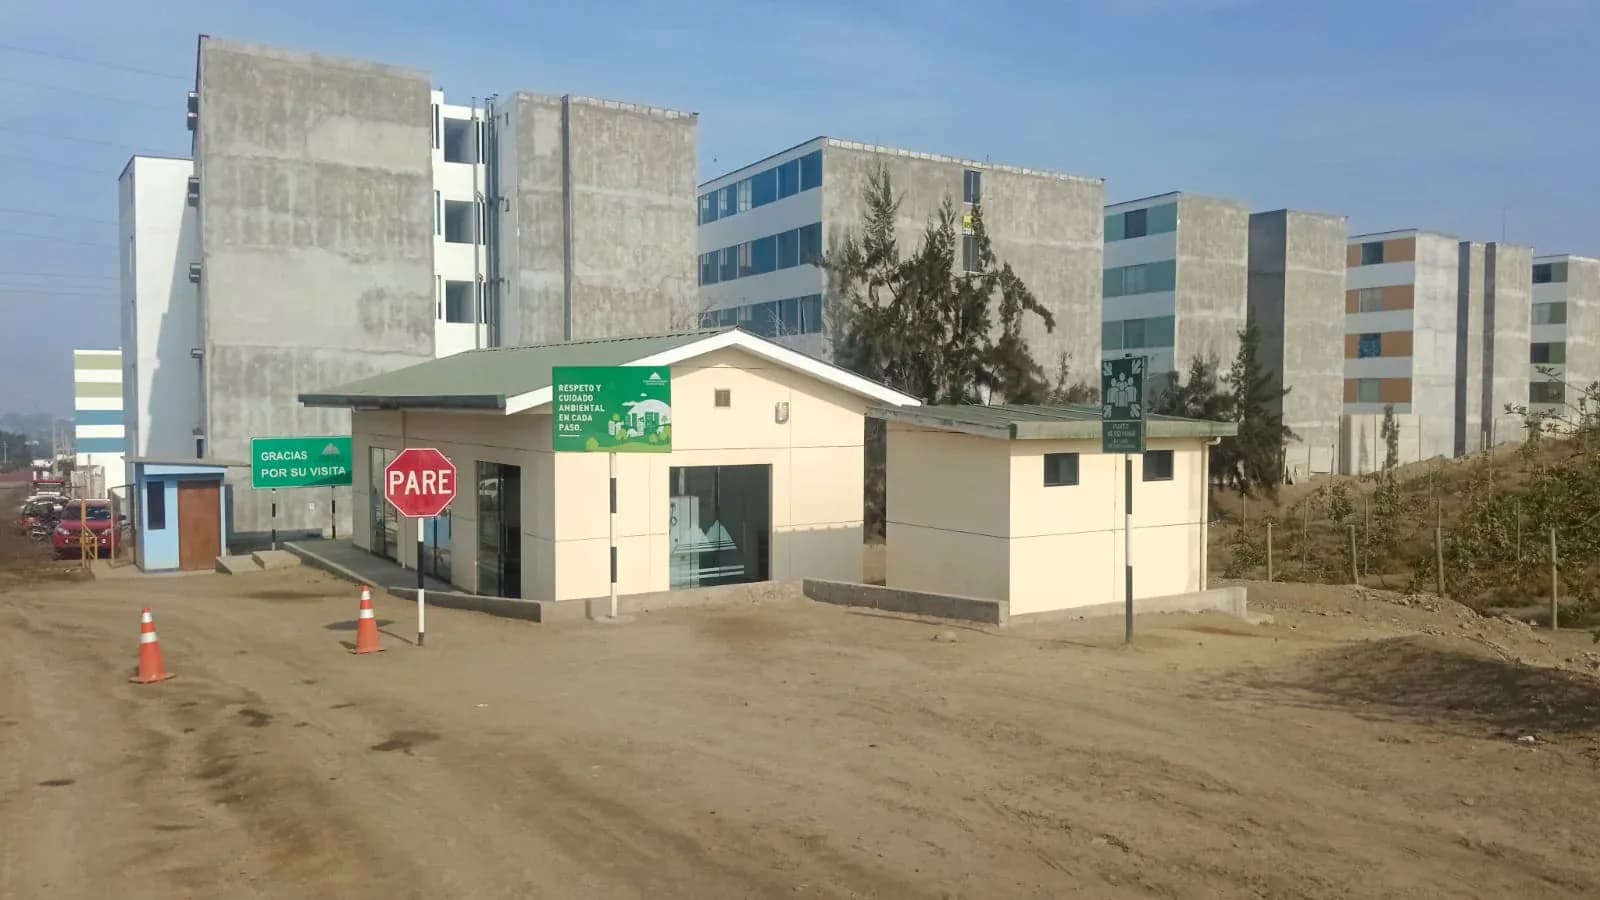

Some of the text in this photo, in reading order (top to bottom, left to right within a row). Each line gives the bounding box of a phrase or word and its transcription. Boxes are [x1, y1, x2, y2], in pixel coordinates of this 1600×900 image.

[558, 384, 602, 392] RESPETO Y
[558, 394, 594, 402] CUIDADO
[558, 404, 605, 412] AMBIENTAL
[559, 414, 593, 422] EN CADA
[261, 451, 308, 461] GRACIAS
[261, 466, 346, 478] POR SU VISITA
[389, 469, 452, 496] PARE
